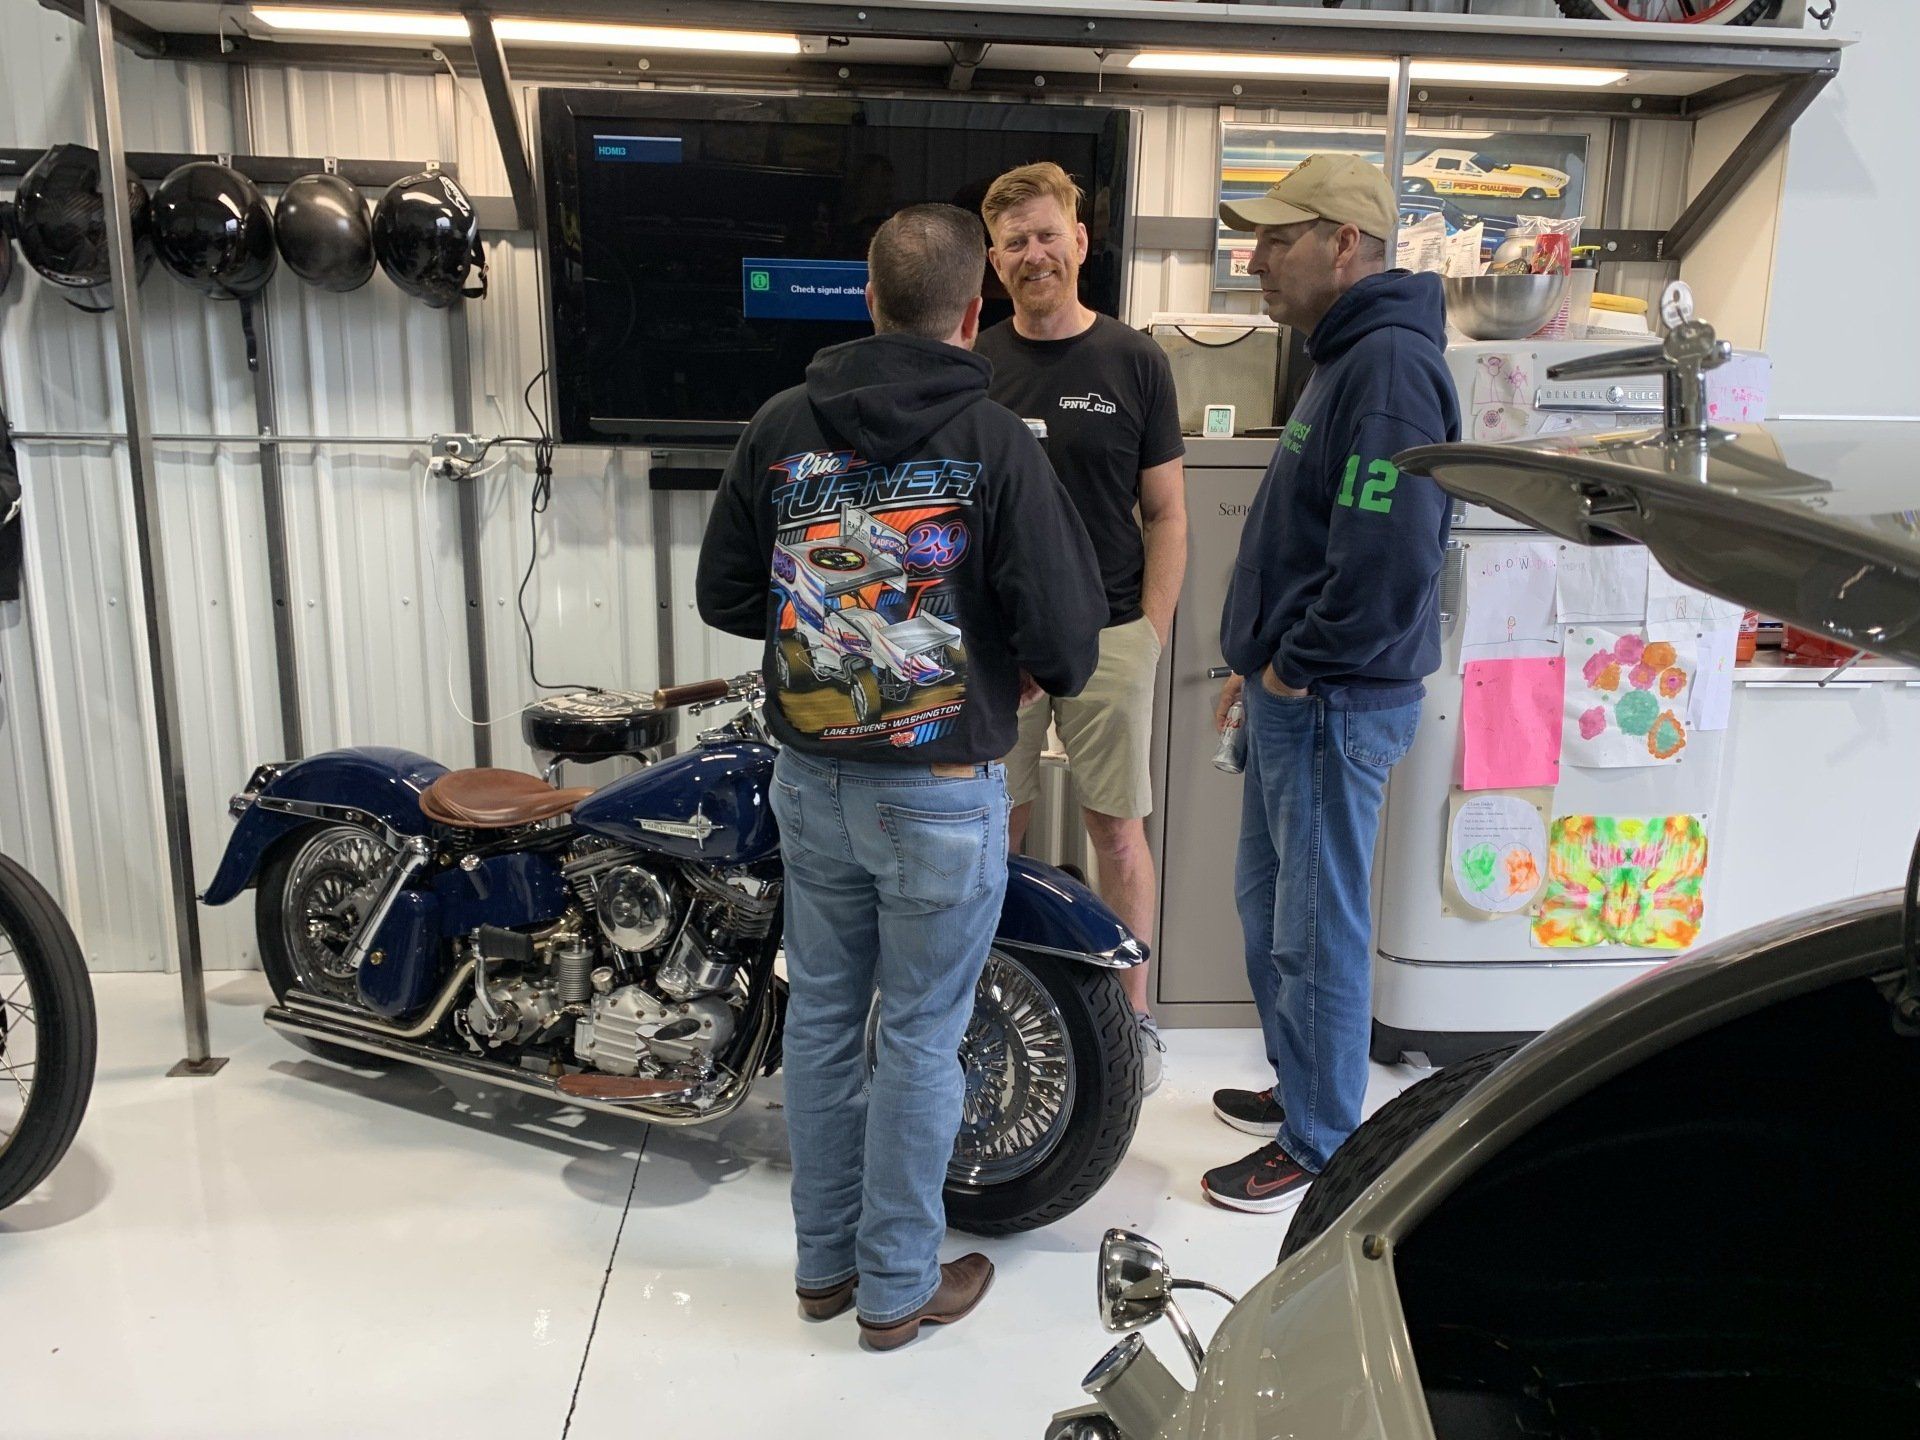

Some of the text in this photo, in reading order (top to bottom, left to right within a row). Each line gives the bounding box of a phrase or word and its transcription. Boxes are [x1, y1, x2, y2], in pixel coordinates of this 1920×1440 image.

[598, 146, 626, 156] HDMI3
[1453, 182, 1479, 191] PEPSI
[790, 284, 816, 294] Check
[817, 285, 841, 296] signal
[1546, 390, 1603, 399] GENERAL
[1062, 400, 1113, 414] PNW_C10
[797, 452, 843, 482] Eric
[771, 459, 982, 524] TURNER
[1338, 454, 1400, 514] 12
[903, 520, 970, 571] 29
[823, 704, 962, 736] LAKE STEVENS WASHINGTON
